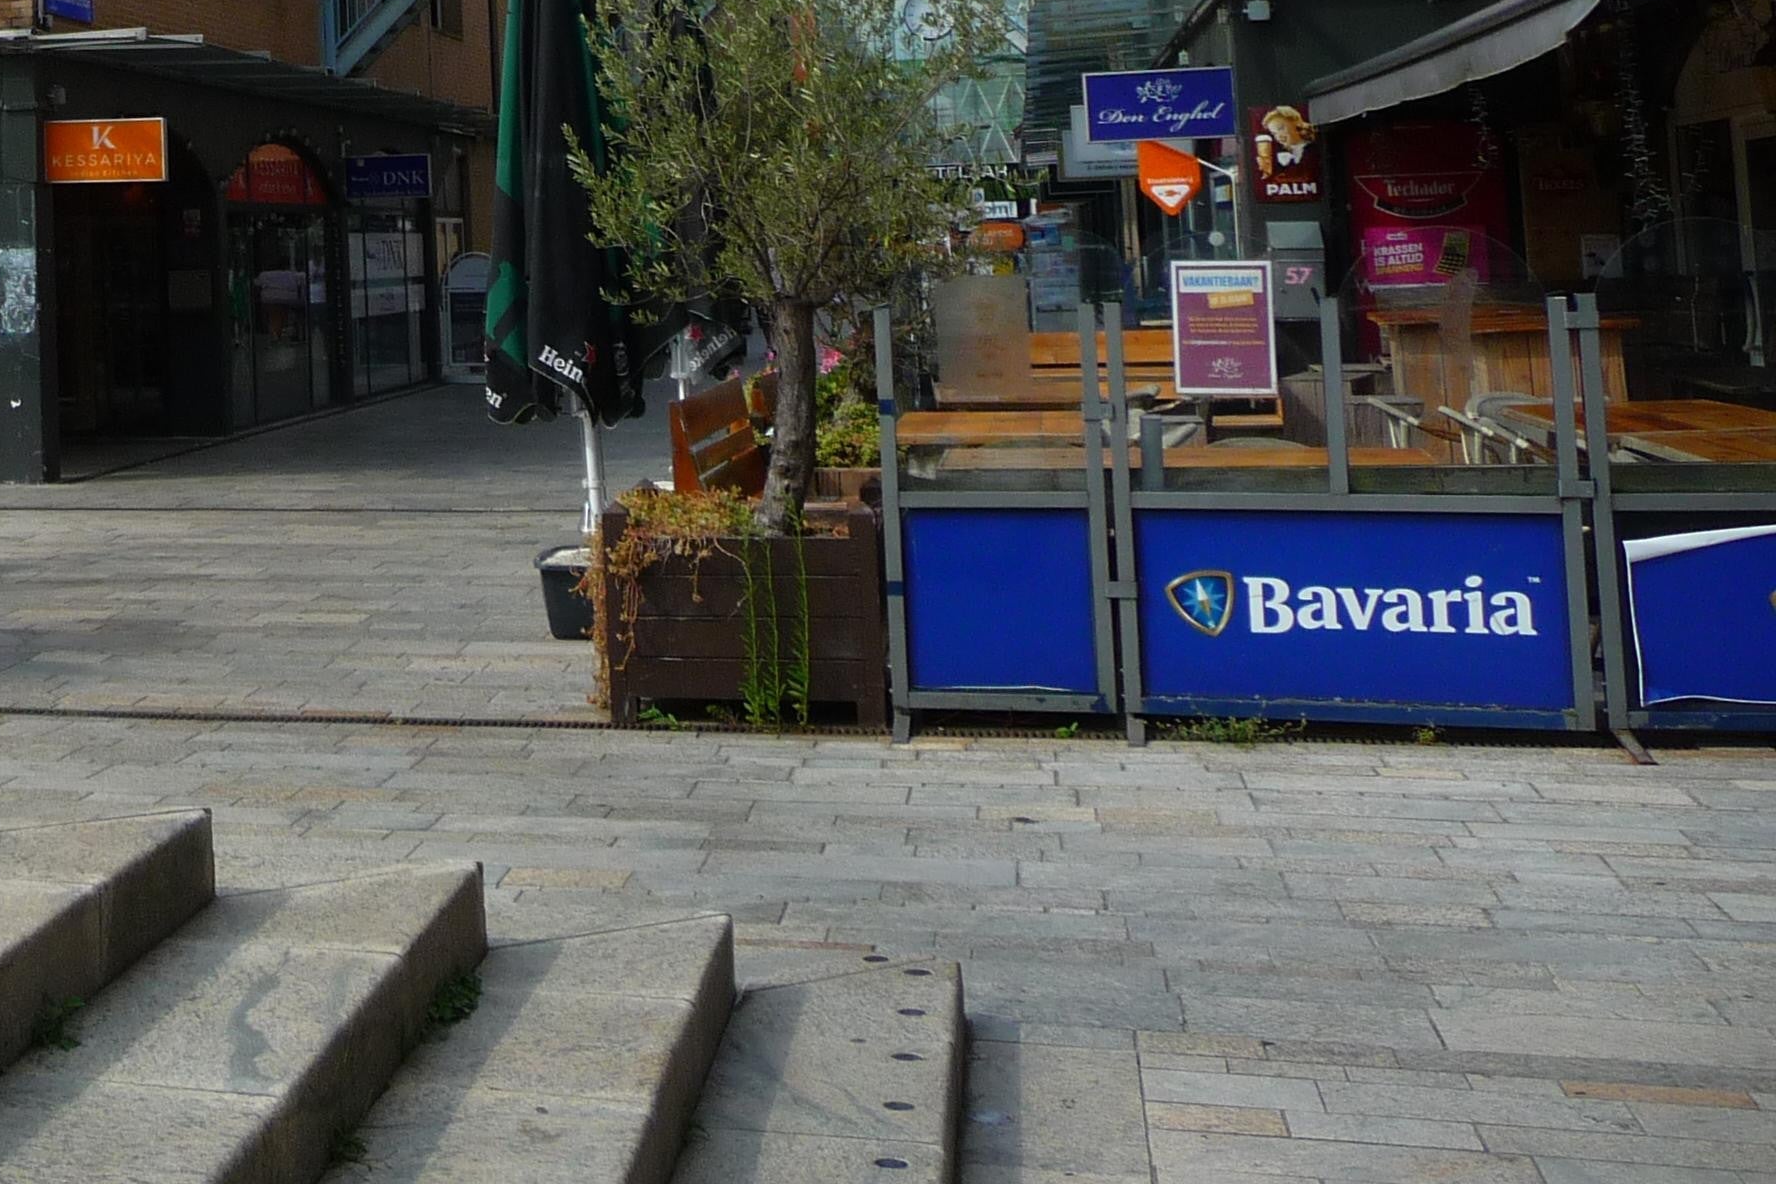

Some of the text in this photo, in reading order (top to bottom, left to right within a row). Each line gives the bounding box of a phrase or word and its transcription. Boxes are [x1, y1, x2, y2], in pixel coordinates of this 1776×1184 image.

[1097, 100, 1225, 133] Den Enghel
[91, 125, 117, 150] K
[51, 153, 157, 168] KESSARIYA
[384, 170, 425, 186] DNK
[1266, 182, 1318, 197] PALM
[1285, 266, 1312, 286] 57
[537, 344, 584, 384] Hein
[1242, 575, 1538, 636] Bavaria
